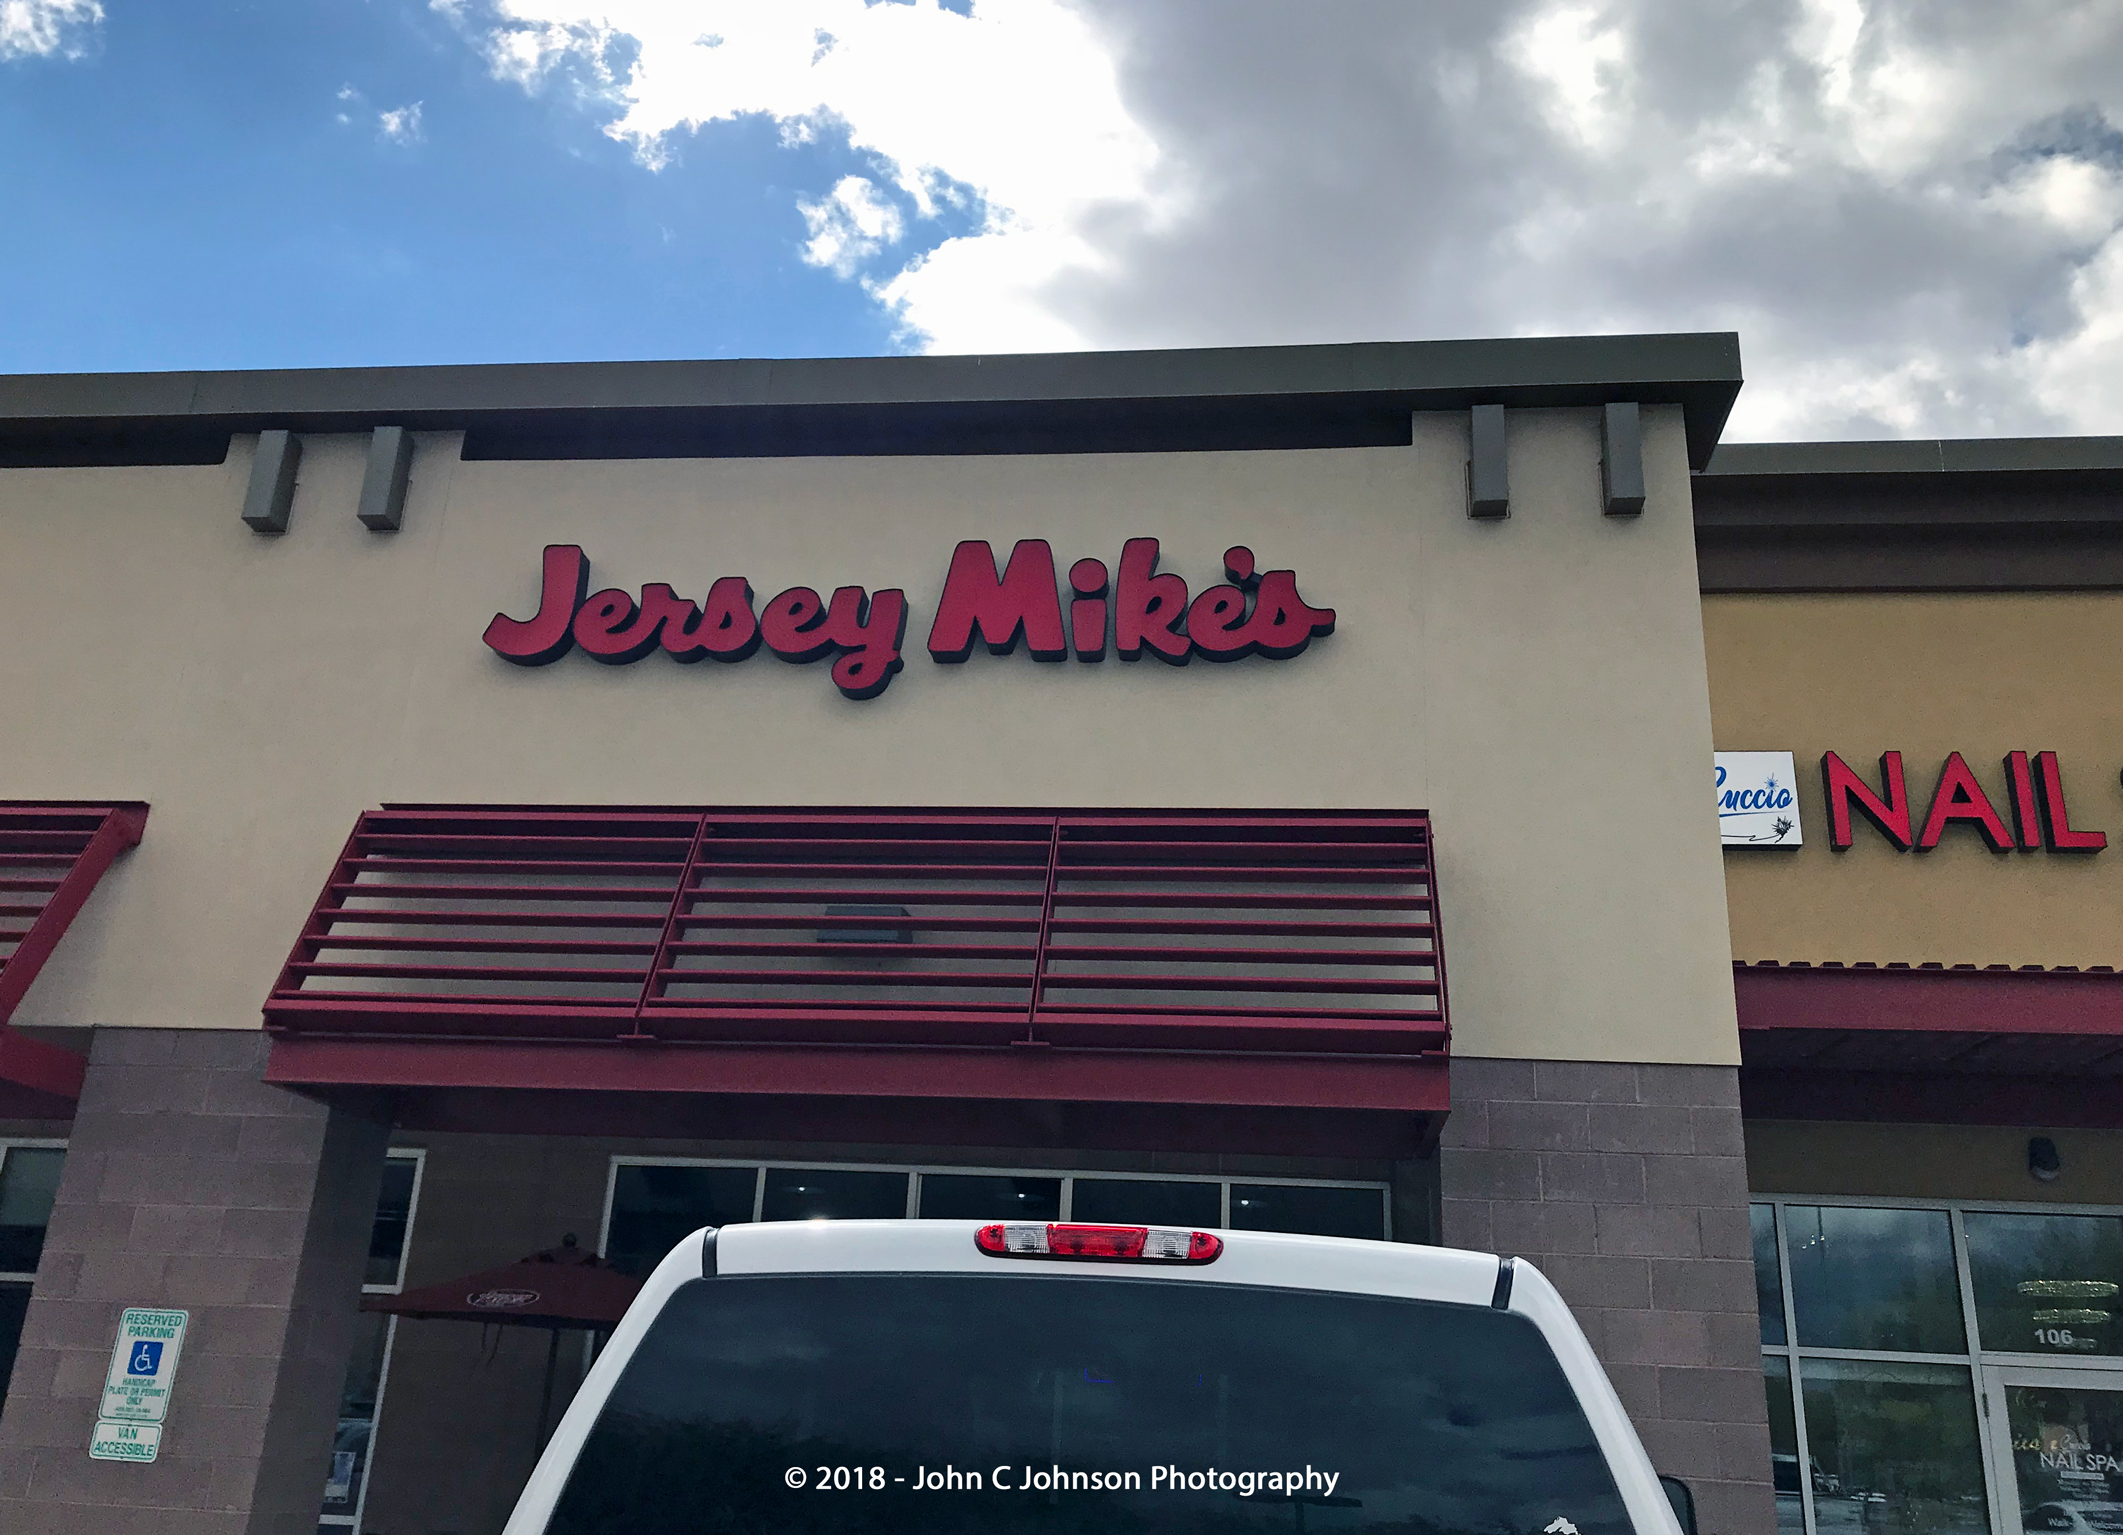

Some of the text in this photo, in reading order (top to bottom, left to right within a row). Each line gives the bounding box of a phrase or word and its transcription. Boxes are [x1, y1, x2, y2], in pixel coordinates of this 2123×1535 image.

[482, 537, 1336, 700] Jersey Mike's
[1821, 751, 2107, 854] NAIL
[125, 1313, 182, 1327] RESERVED
[127, 1327, 175, 1339] PARKING
[2034, 1328, 2073, 1345] 106
[122, 1378, 156, 1387] HANDICAP
[108, 1385, 128, 1395] PLATE
[130, 1387, 140, 1396] OR
[118, 1427, 138, 1440] VAN
[94, 1441, 155, 1456] ACCESSIBLE
[2039, 1452, 2121, 1473] NAIL SPA
